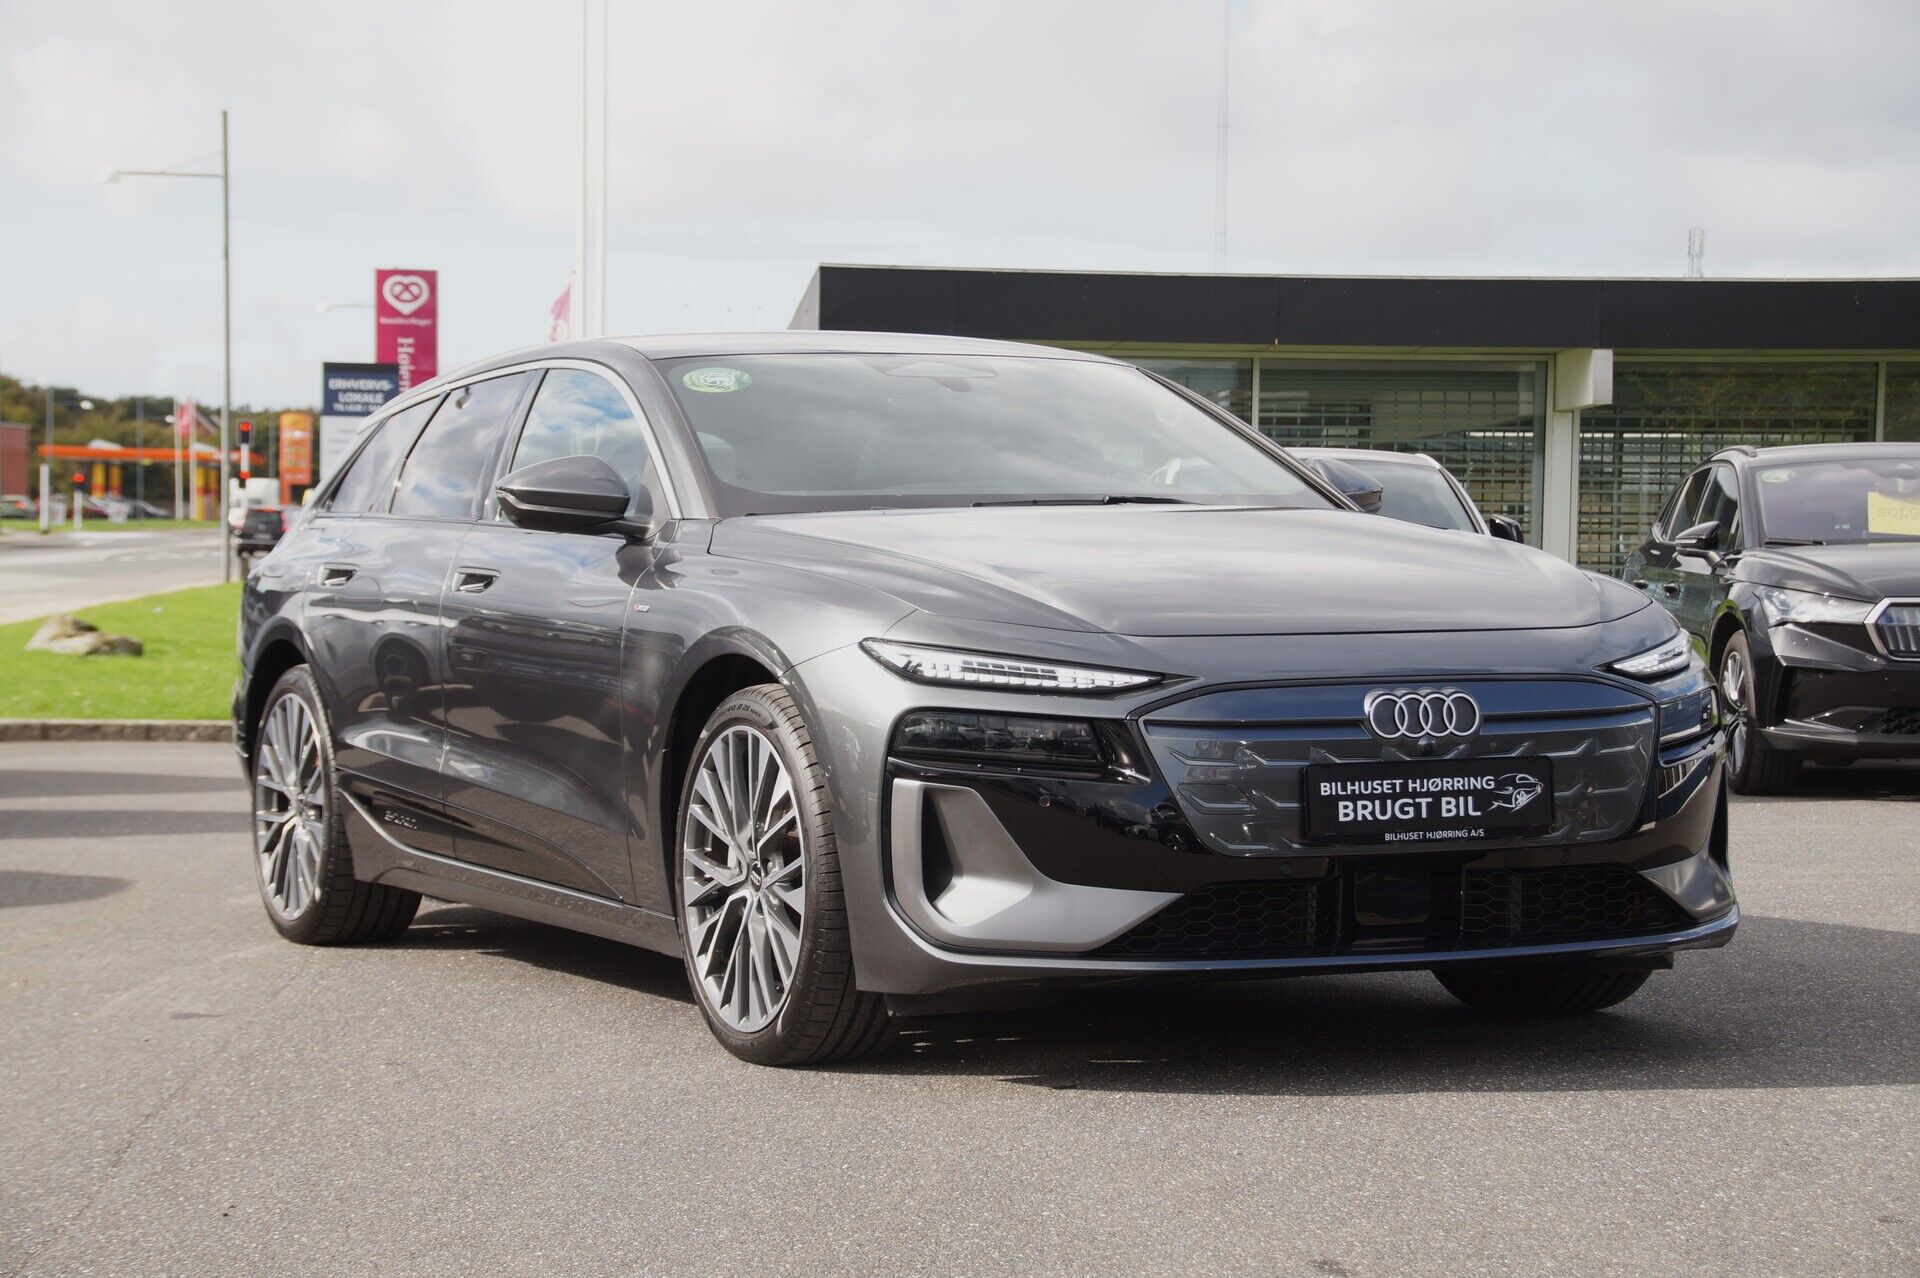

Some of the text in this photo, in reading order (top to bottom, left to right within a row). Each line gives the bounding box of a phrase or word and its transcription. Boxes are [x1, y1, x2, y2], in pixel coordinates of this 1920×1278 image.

[1320, 776, 1495, 796] BILHUSET HJØRRING
[1338, 796, 1481, 822] BRUGT BIL
[1384, 828, 1485, 841] BILHUSET HJØRRING A/S
